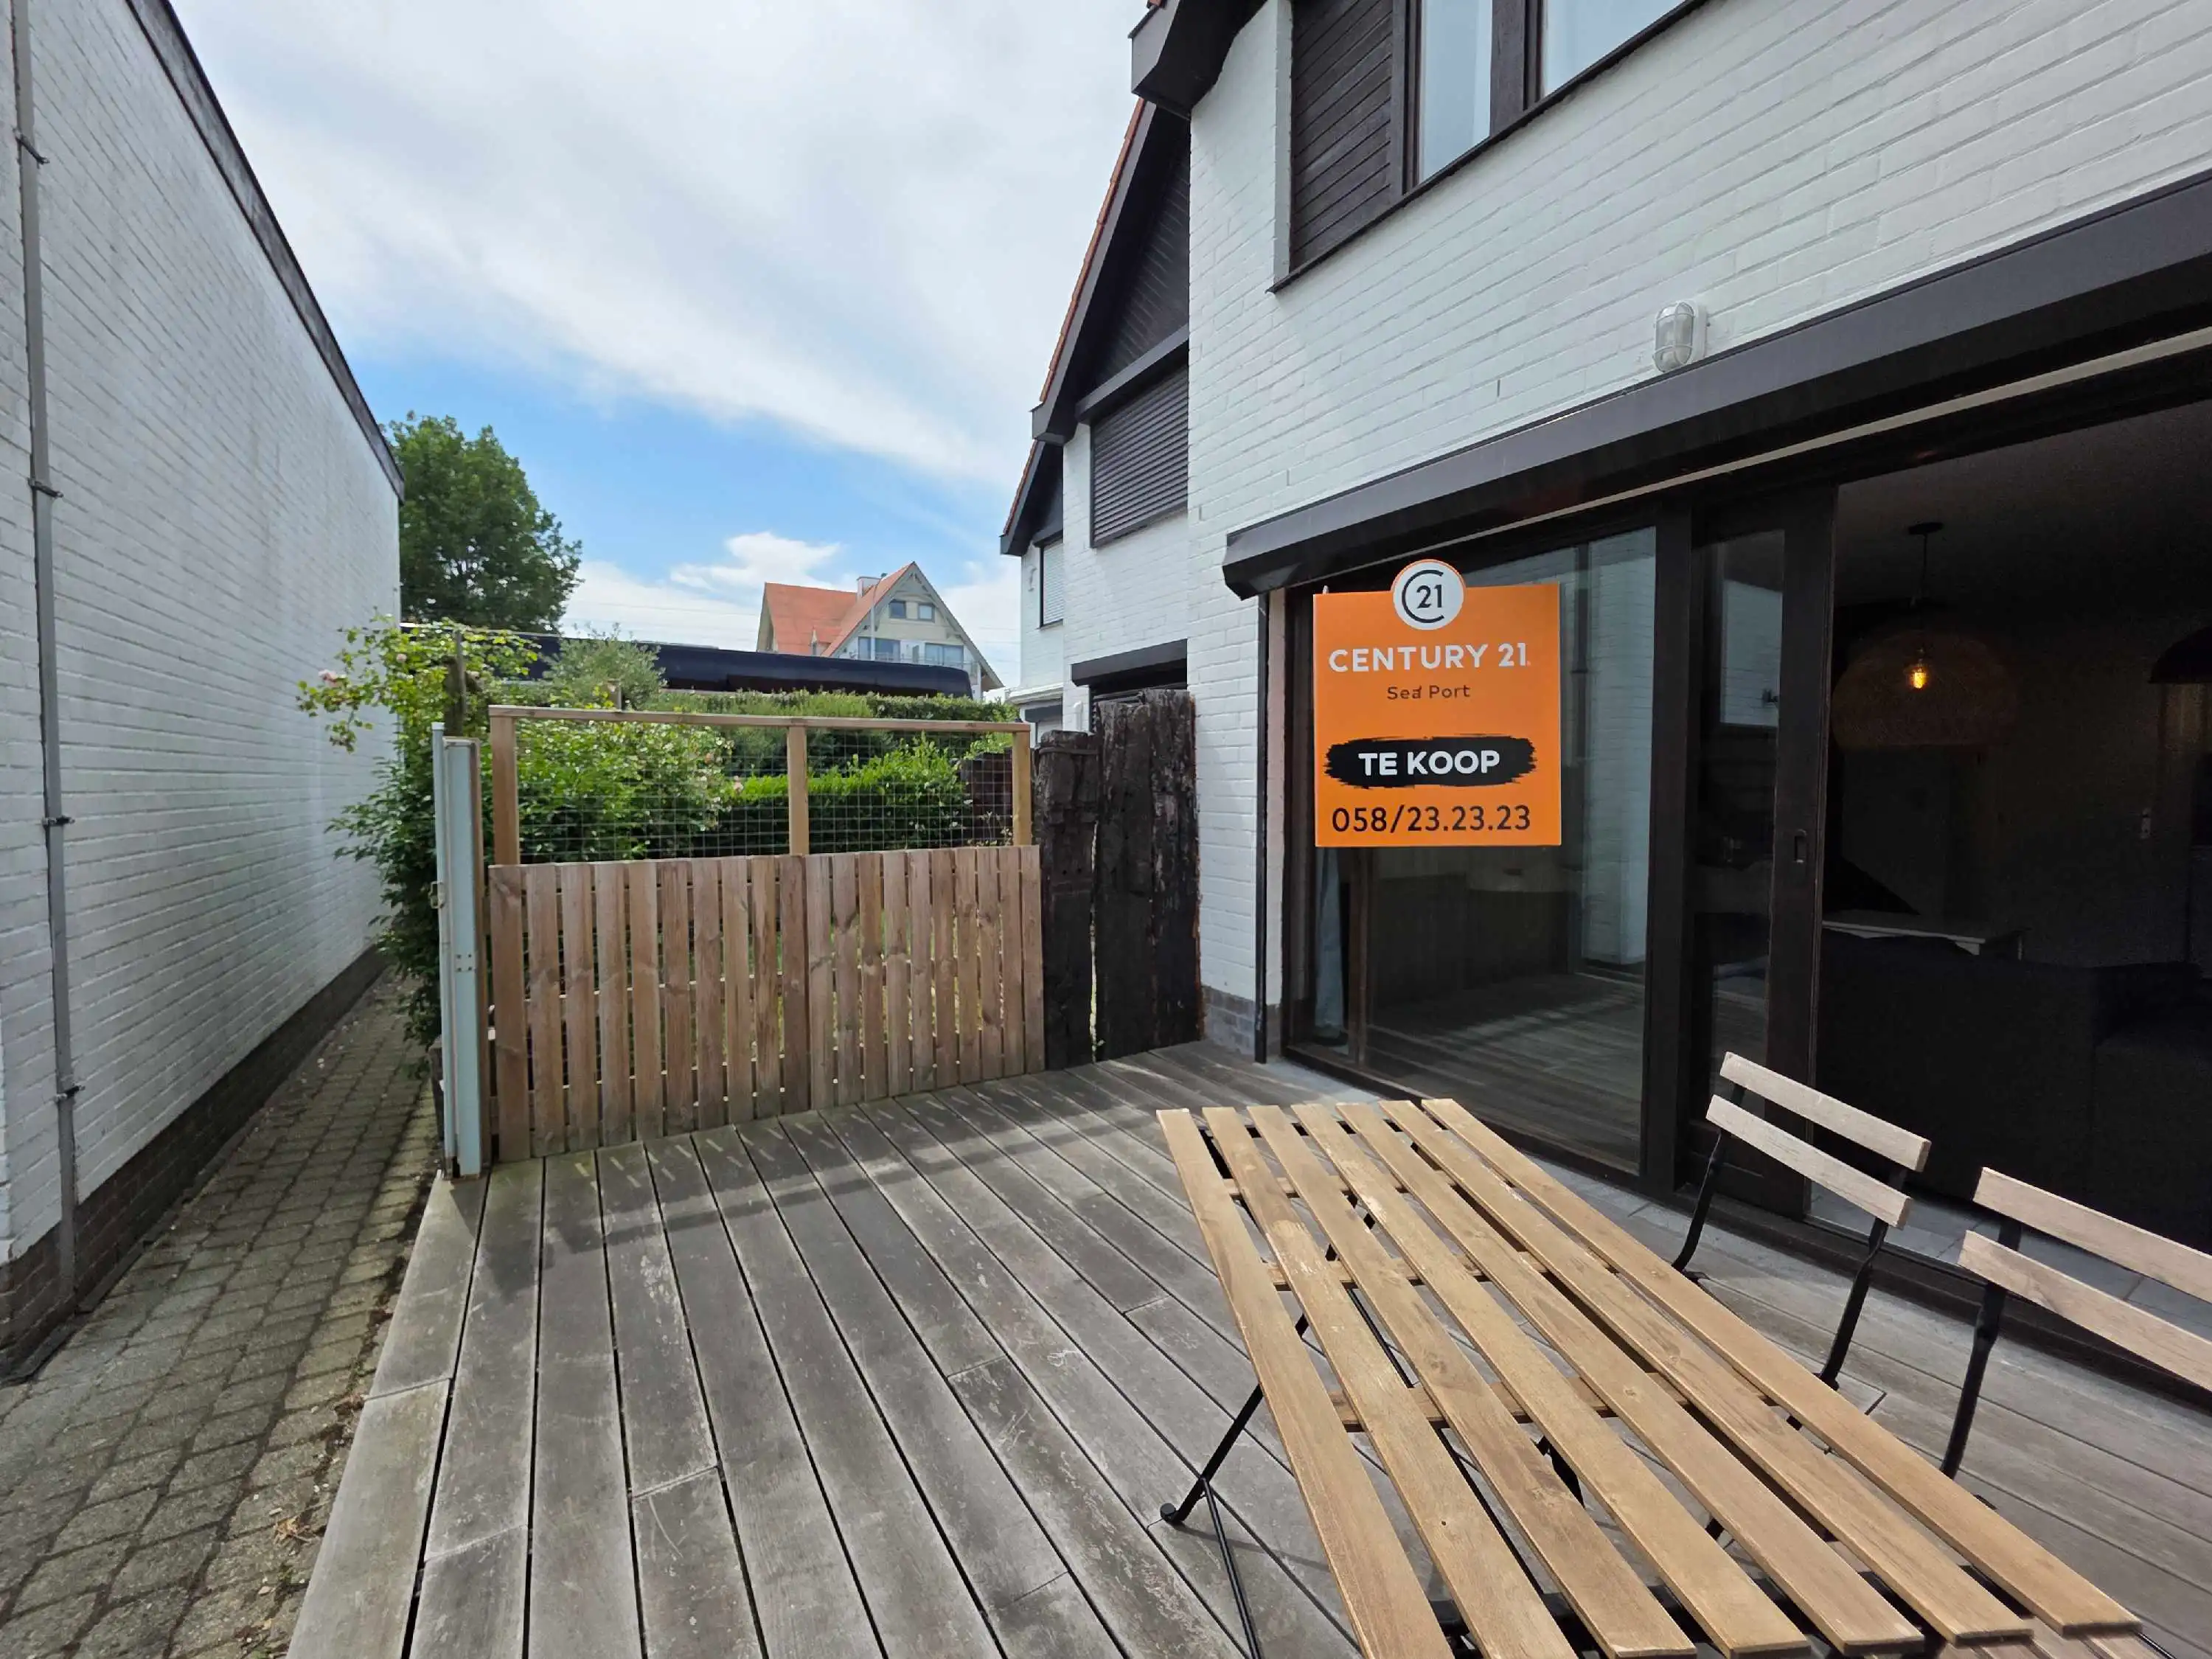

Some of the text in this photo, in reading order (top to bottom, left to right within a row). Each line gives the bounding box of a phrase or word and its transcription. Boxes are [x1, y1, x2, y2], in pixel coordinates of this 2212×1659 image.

[1329, 644, 1489, 672] CENTURY
[1387, 684, 1470, 700] Sea Port
[1358, 751, 1500, 776] TE KOOP
[1332, 804, 1531, 834] 058/23.23.23
